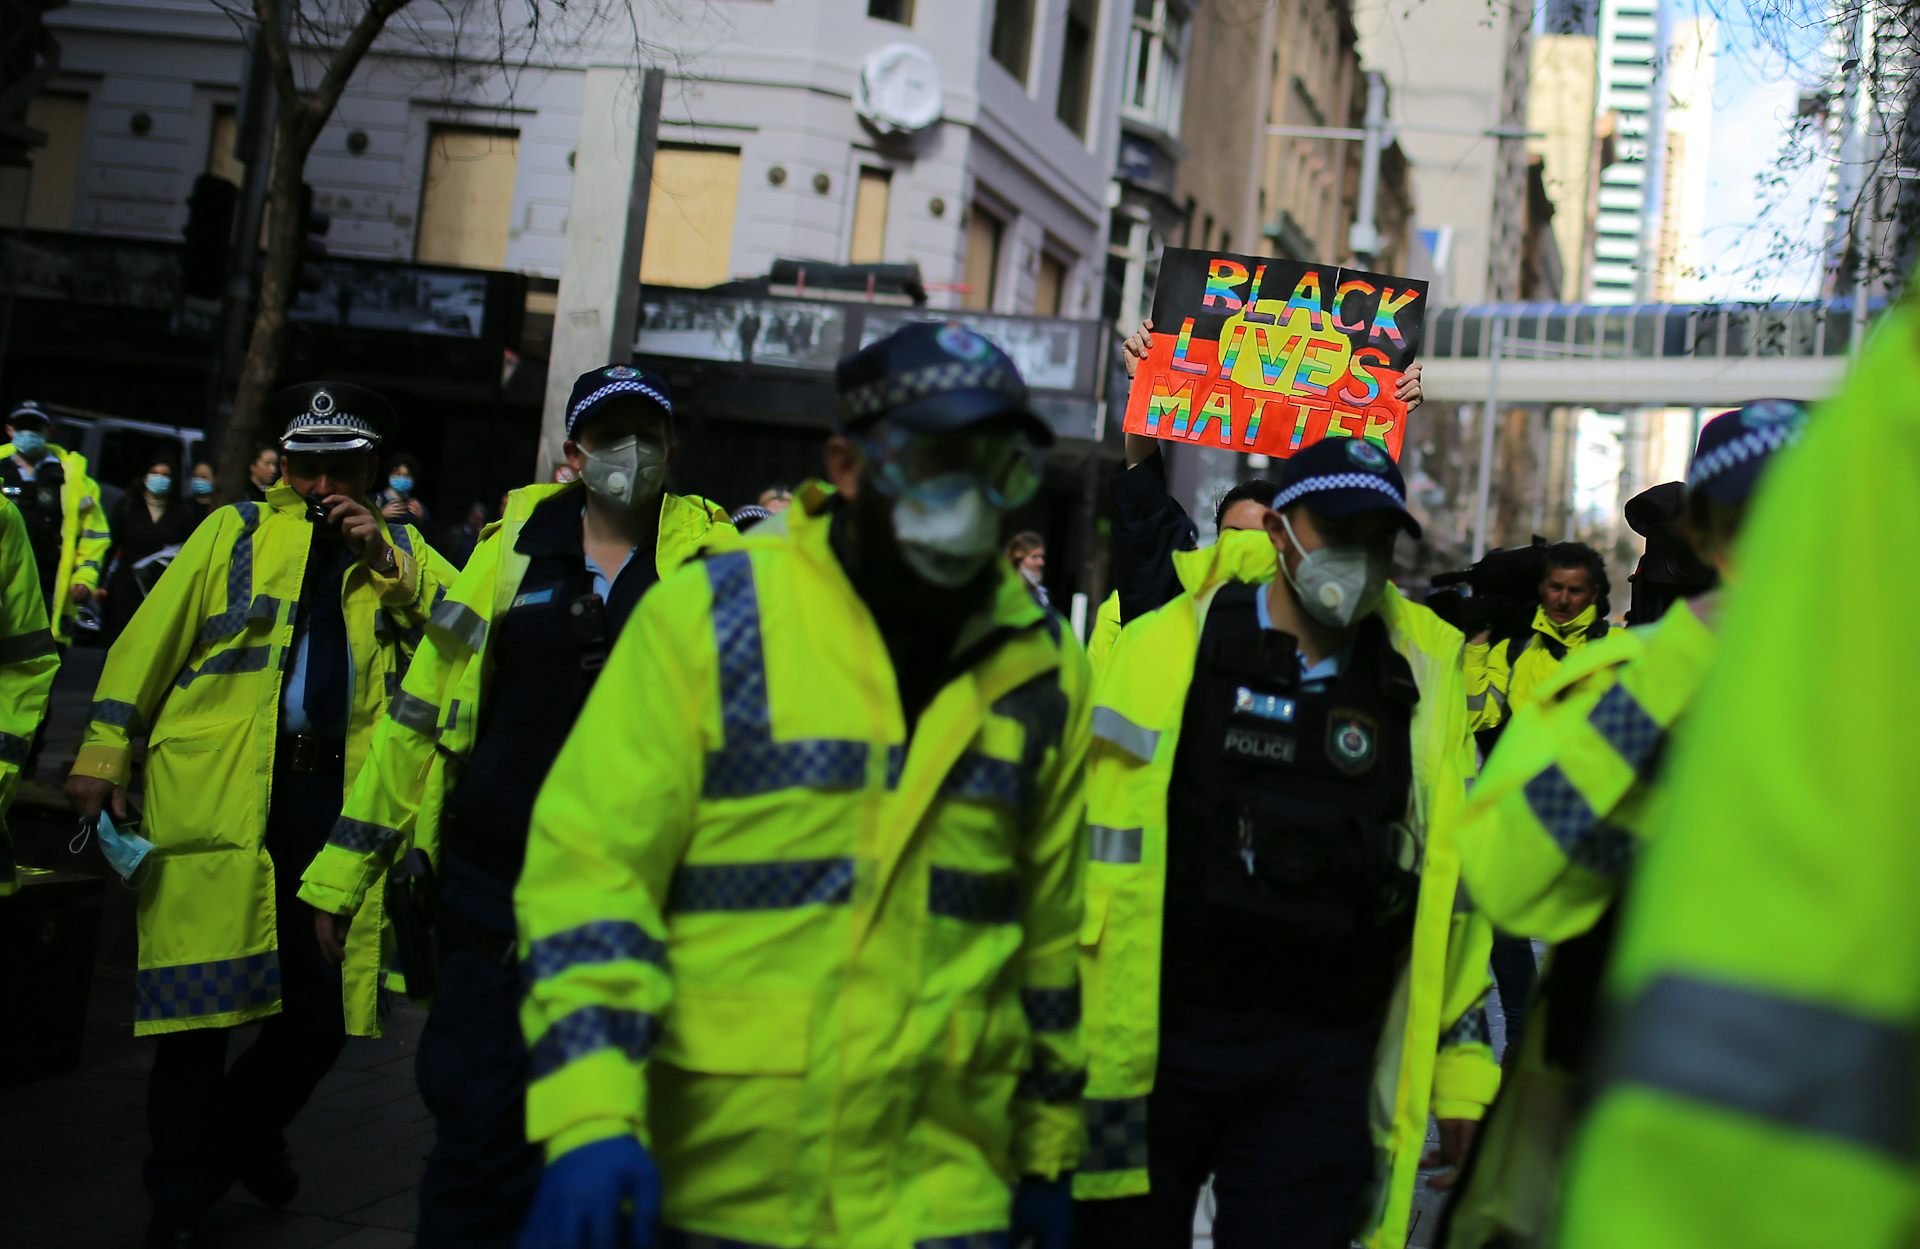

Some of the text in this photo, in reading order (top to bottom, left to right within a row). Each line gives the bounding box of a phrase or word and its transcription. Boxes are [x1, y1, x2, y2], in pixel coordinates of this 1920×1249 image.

[1200, 258, 1420, 349] BLACK
[1171, 317, 1391, 407] LIVES
[1145, 375, 1396, 453] MATTER
[1224, 732, 1294, 763] POLICE
